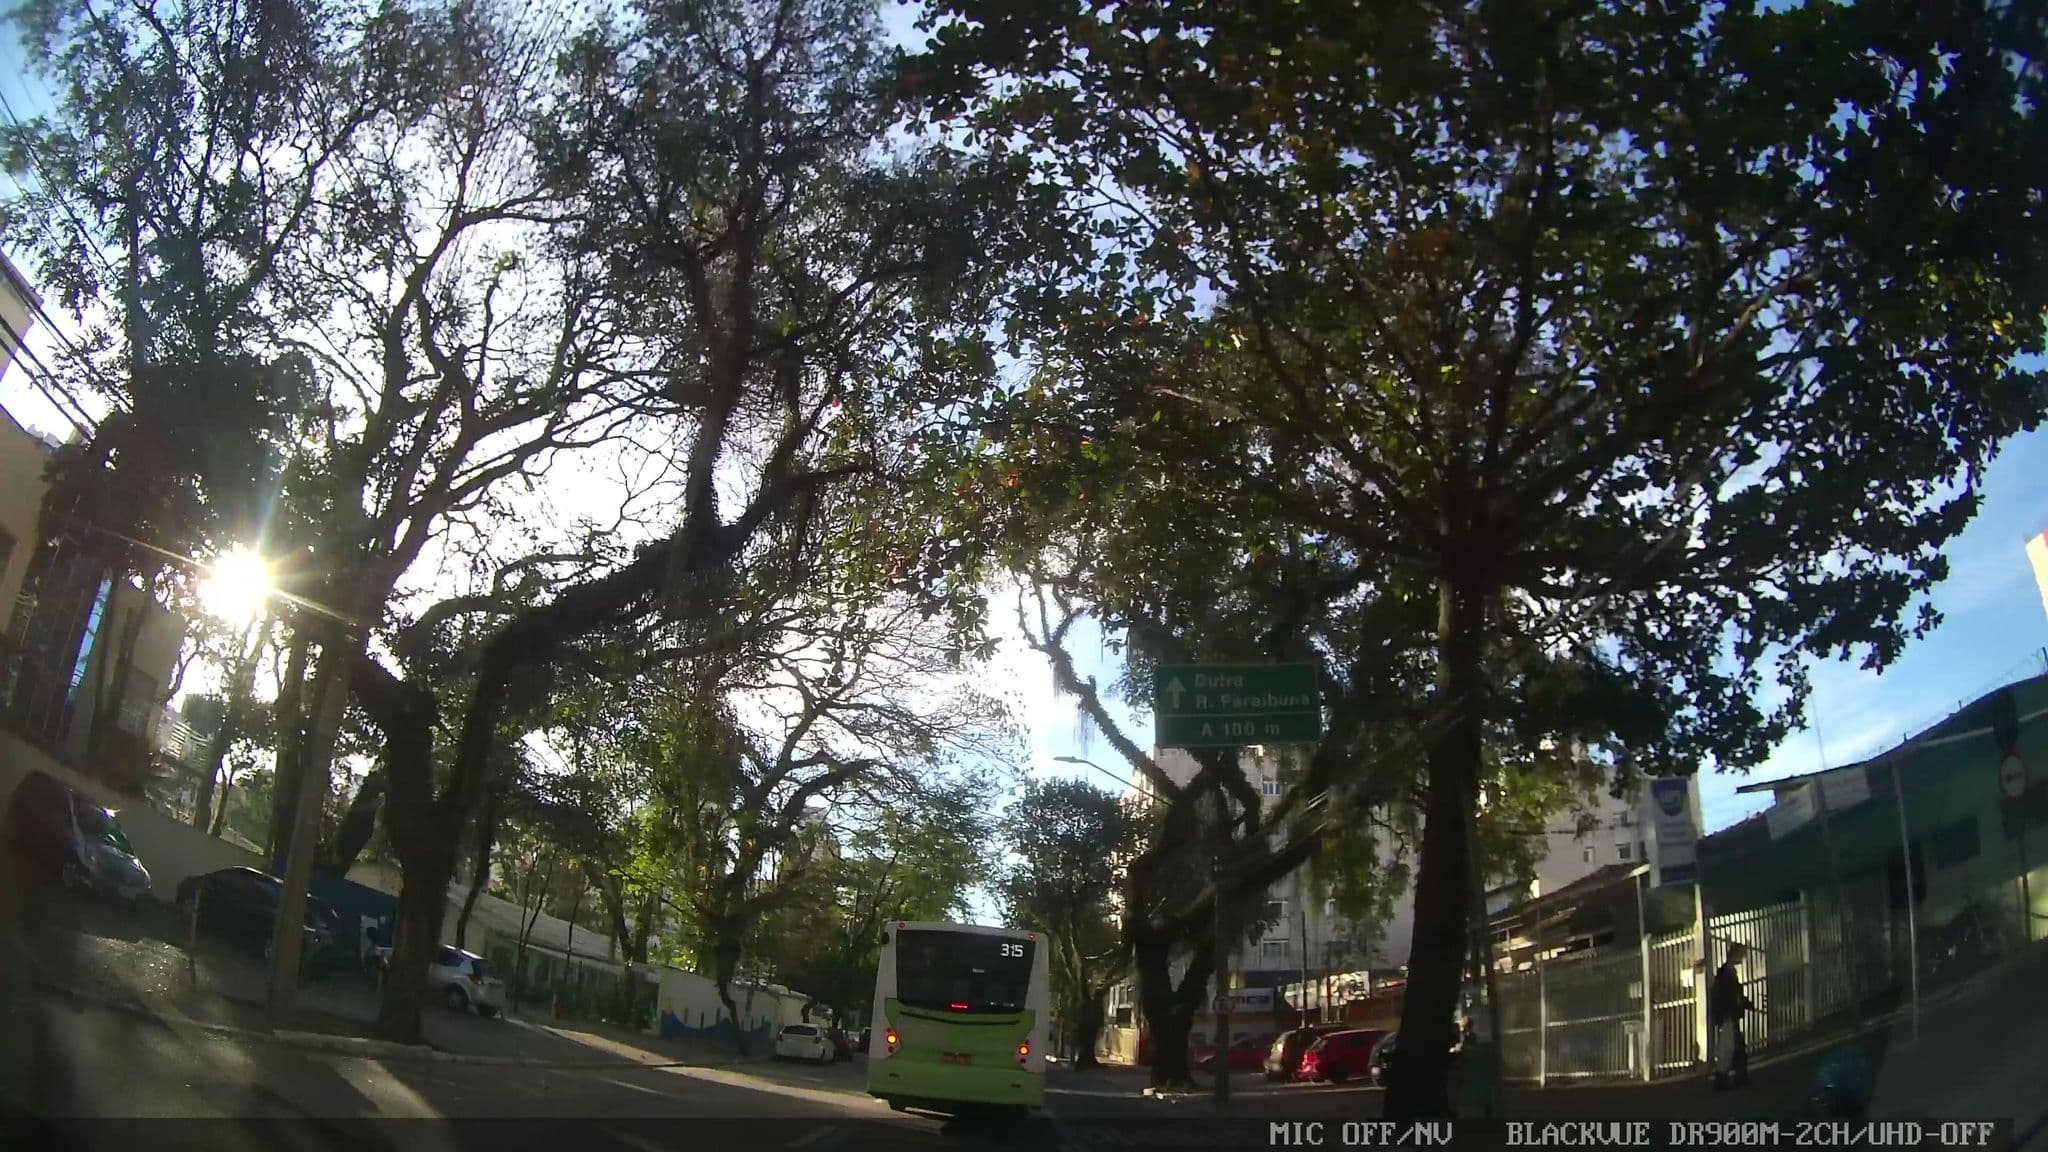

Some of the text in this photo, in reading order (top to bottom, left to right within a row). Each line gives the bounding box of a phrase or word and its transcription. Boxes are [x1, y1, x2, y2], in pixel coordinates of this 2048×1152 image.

[1194, 673, 1244, 689] Dutra
[1196, 694, 1214, 710] R.
[1201, 721, 1281, 737] A 100 m
[1000, 942, 1024, 958] 315
